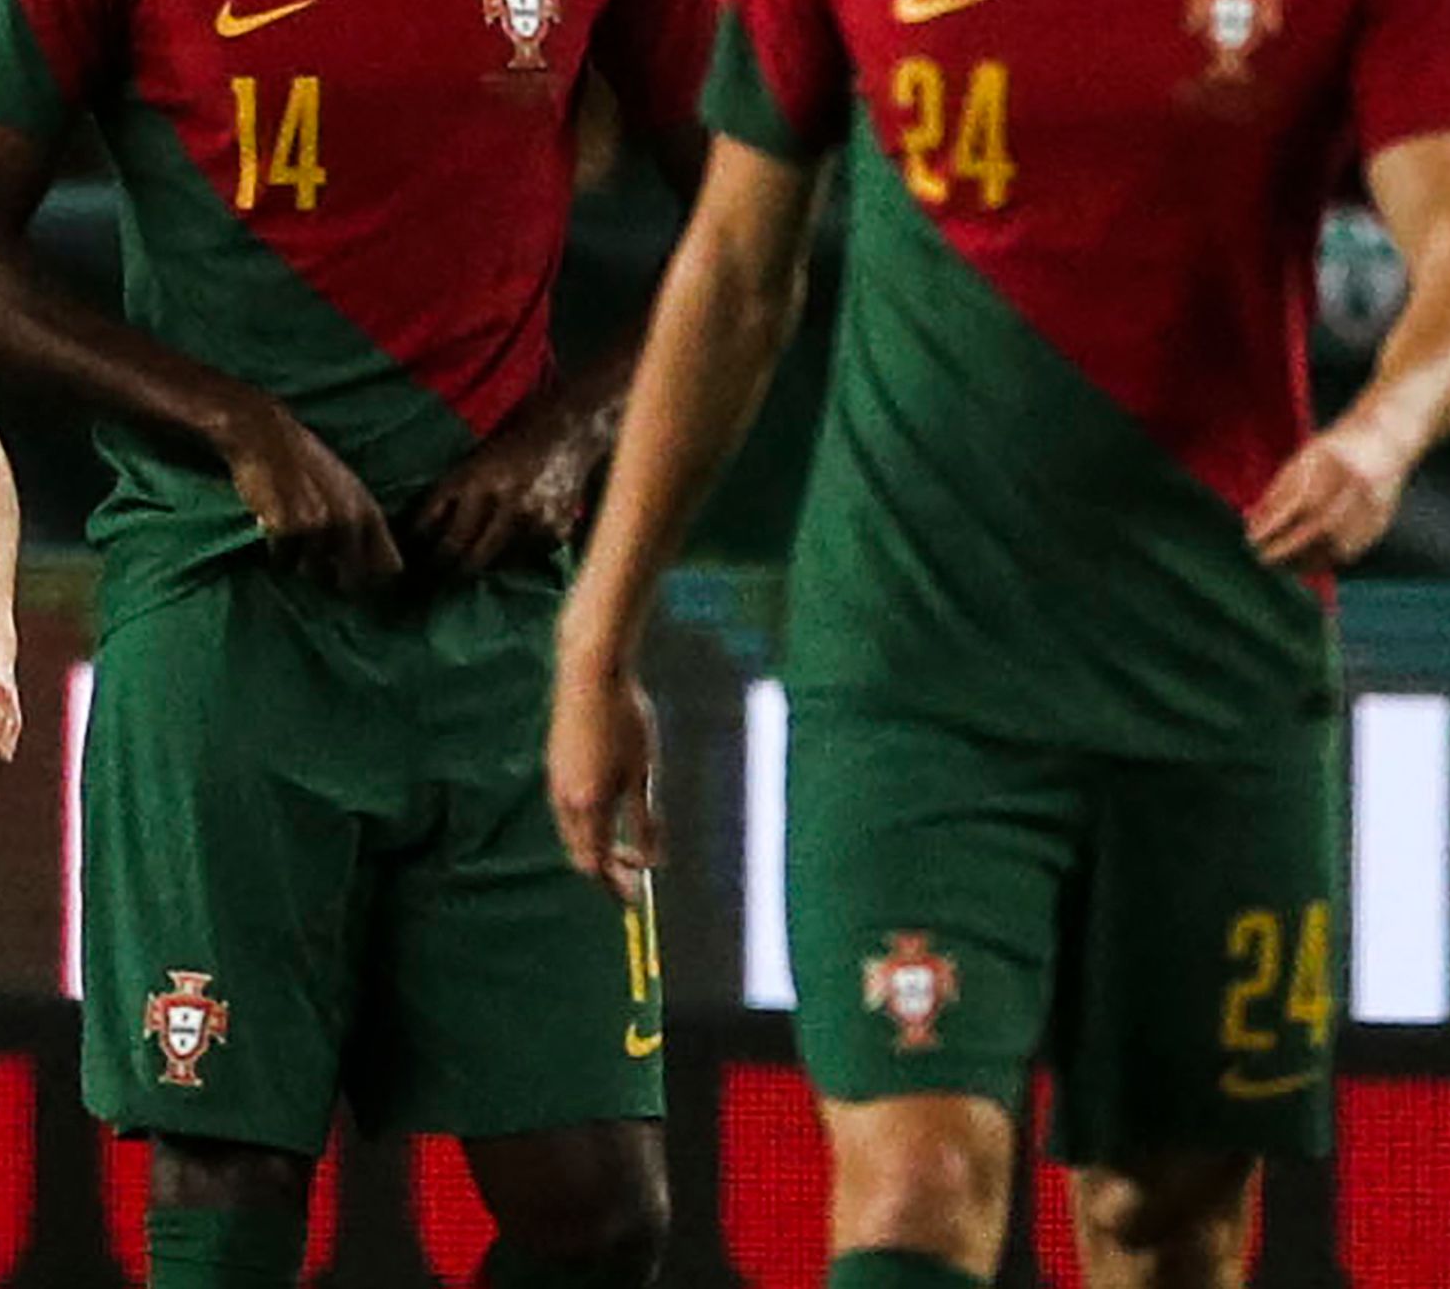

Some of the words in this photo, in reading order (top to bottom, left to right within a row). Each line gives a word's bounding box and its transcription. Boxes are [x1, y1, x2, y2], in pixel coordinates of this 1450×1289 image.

[230, 74, 327, 212] 14
[891, 57, 1017, 209] 24
[1220, 898, 1335, 1051] 24
